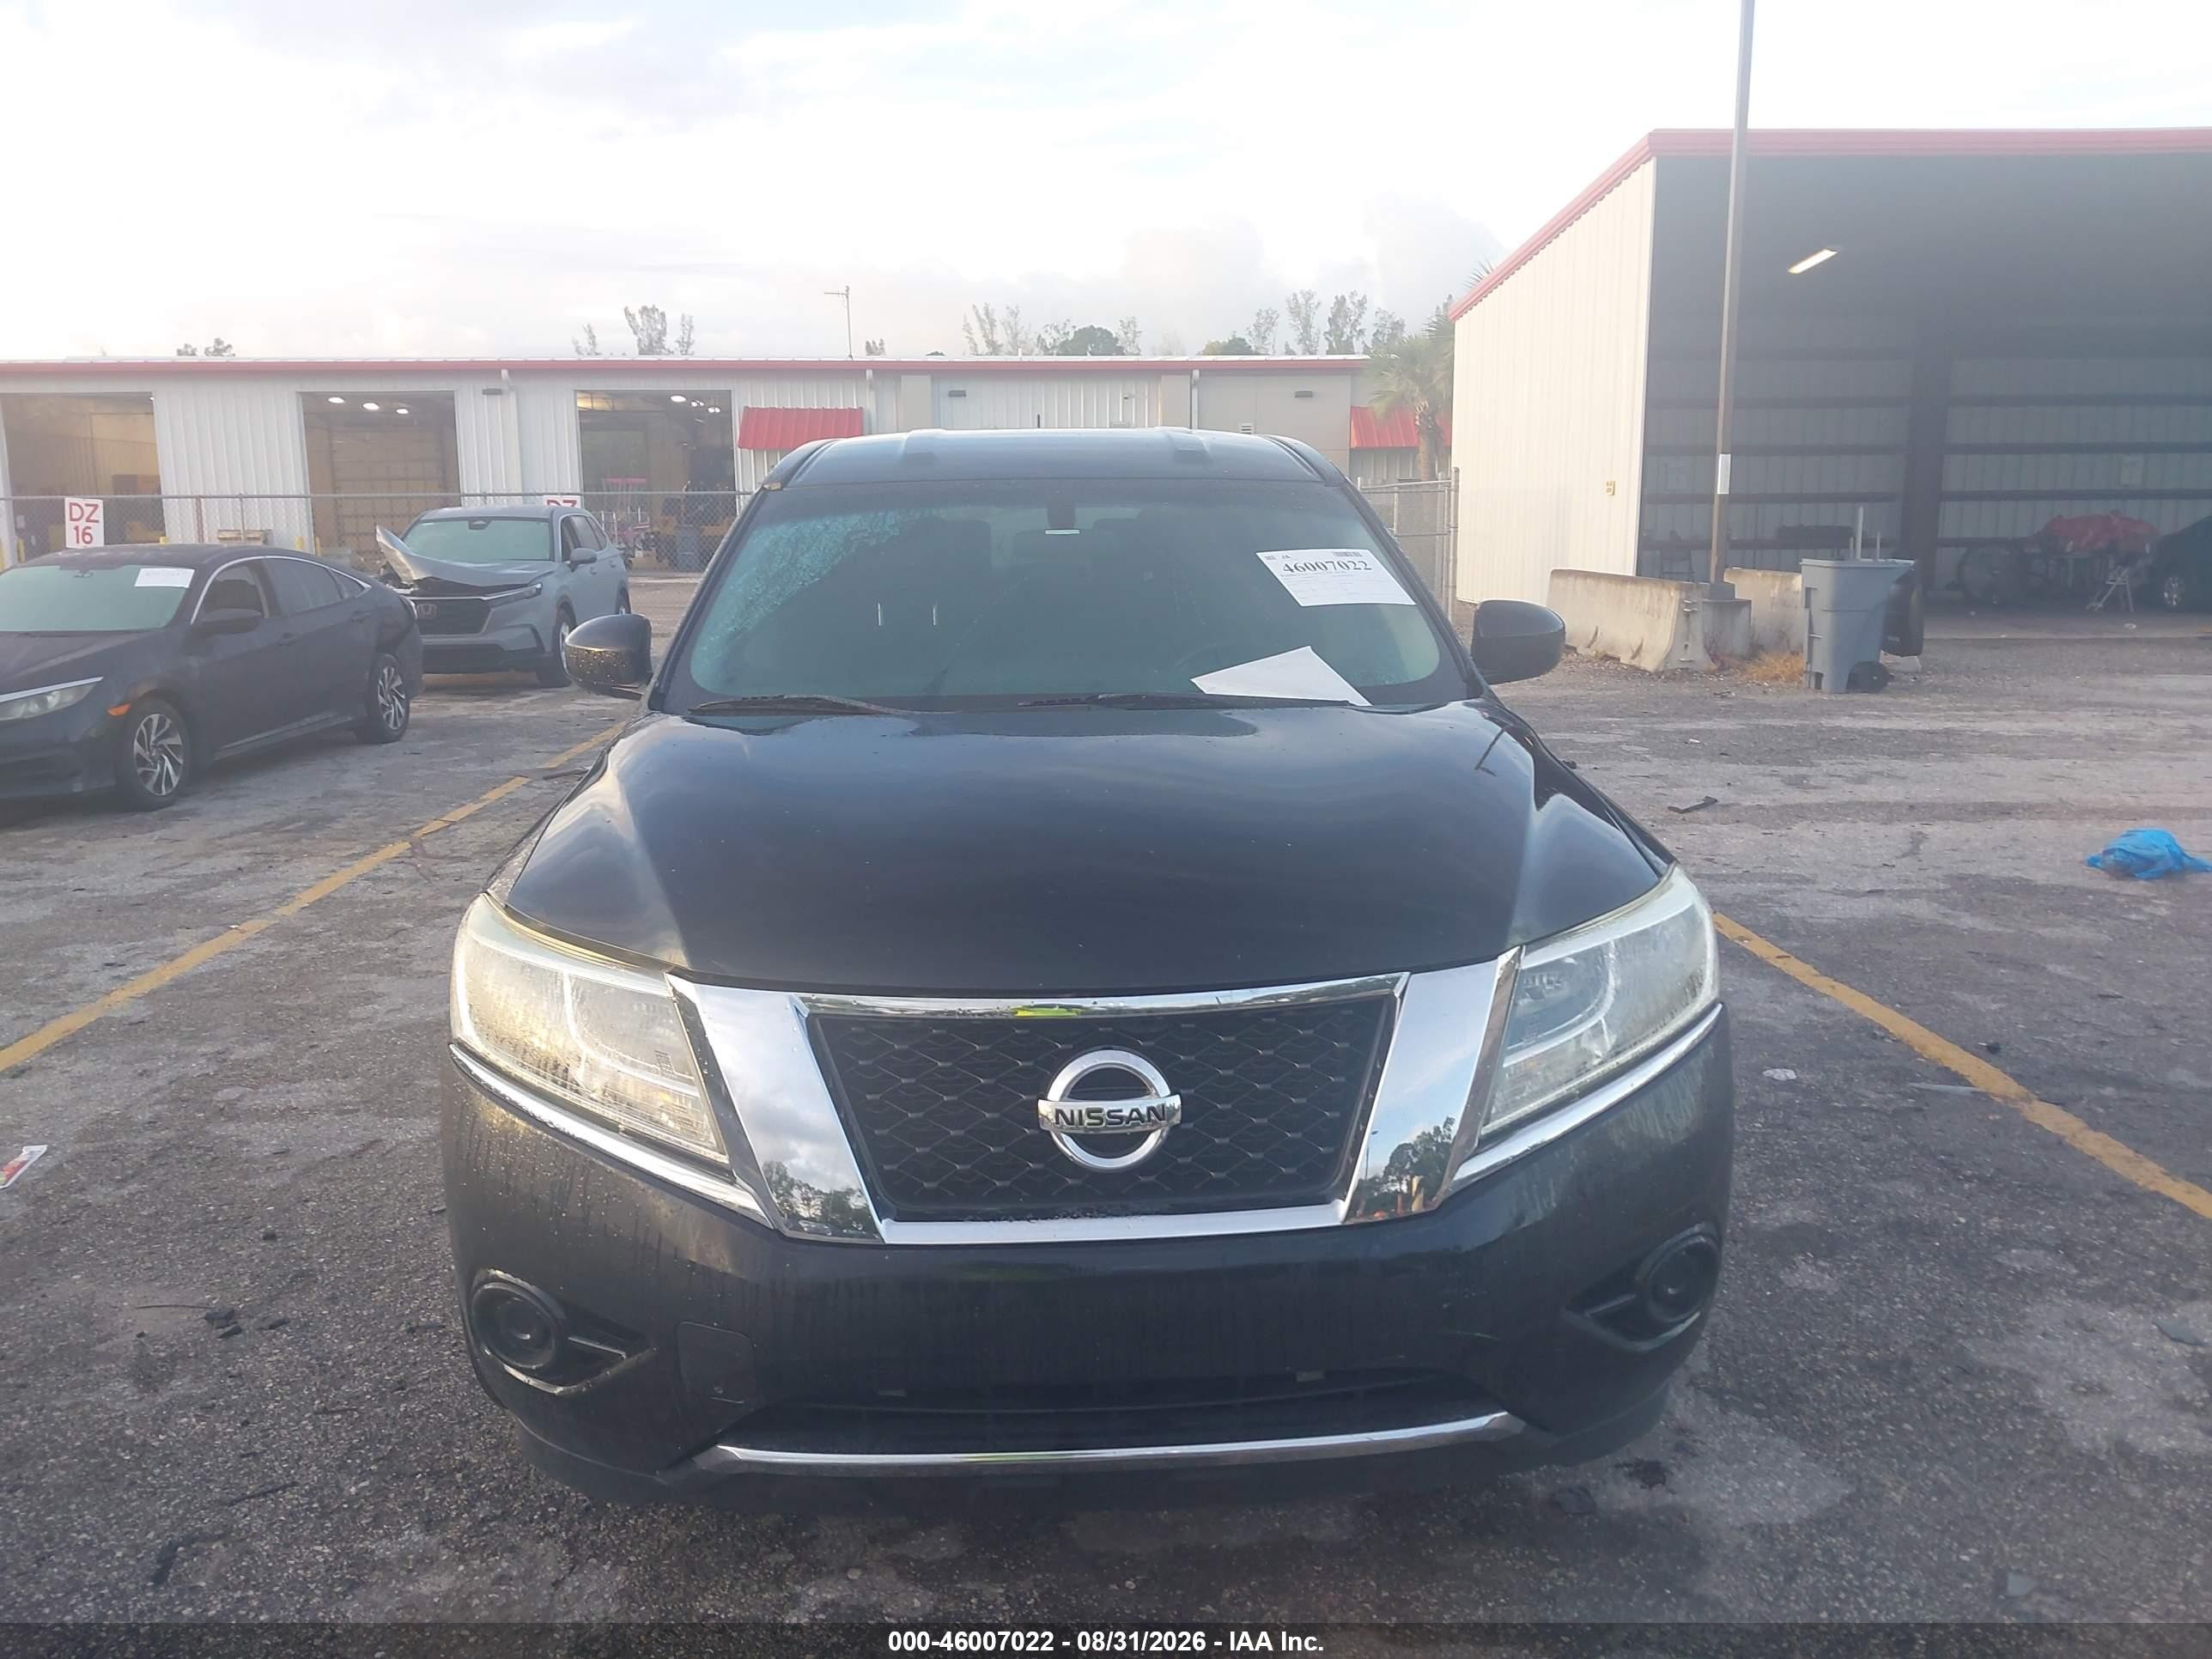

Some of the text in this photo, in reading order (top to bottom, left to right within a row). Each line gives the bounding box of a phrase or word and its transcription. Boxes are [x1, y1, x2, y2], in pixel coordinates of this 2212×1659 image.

[69, 501, 100, 523] DZ
[73, 525, 94, 545] 16
[1283, 560, 1373, 574] 46007022
[1054, 1103, 1165, 1127] NISSAN
